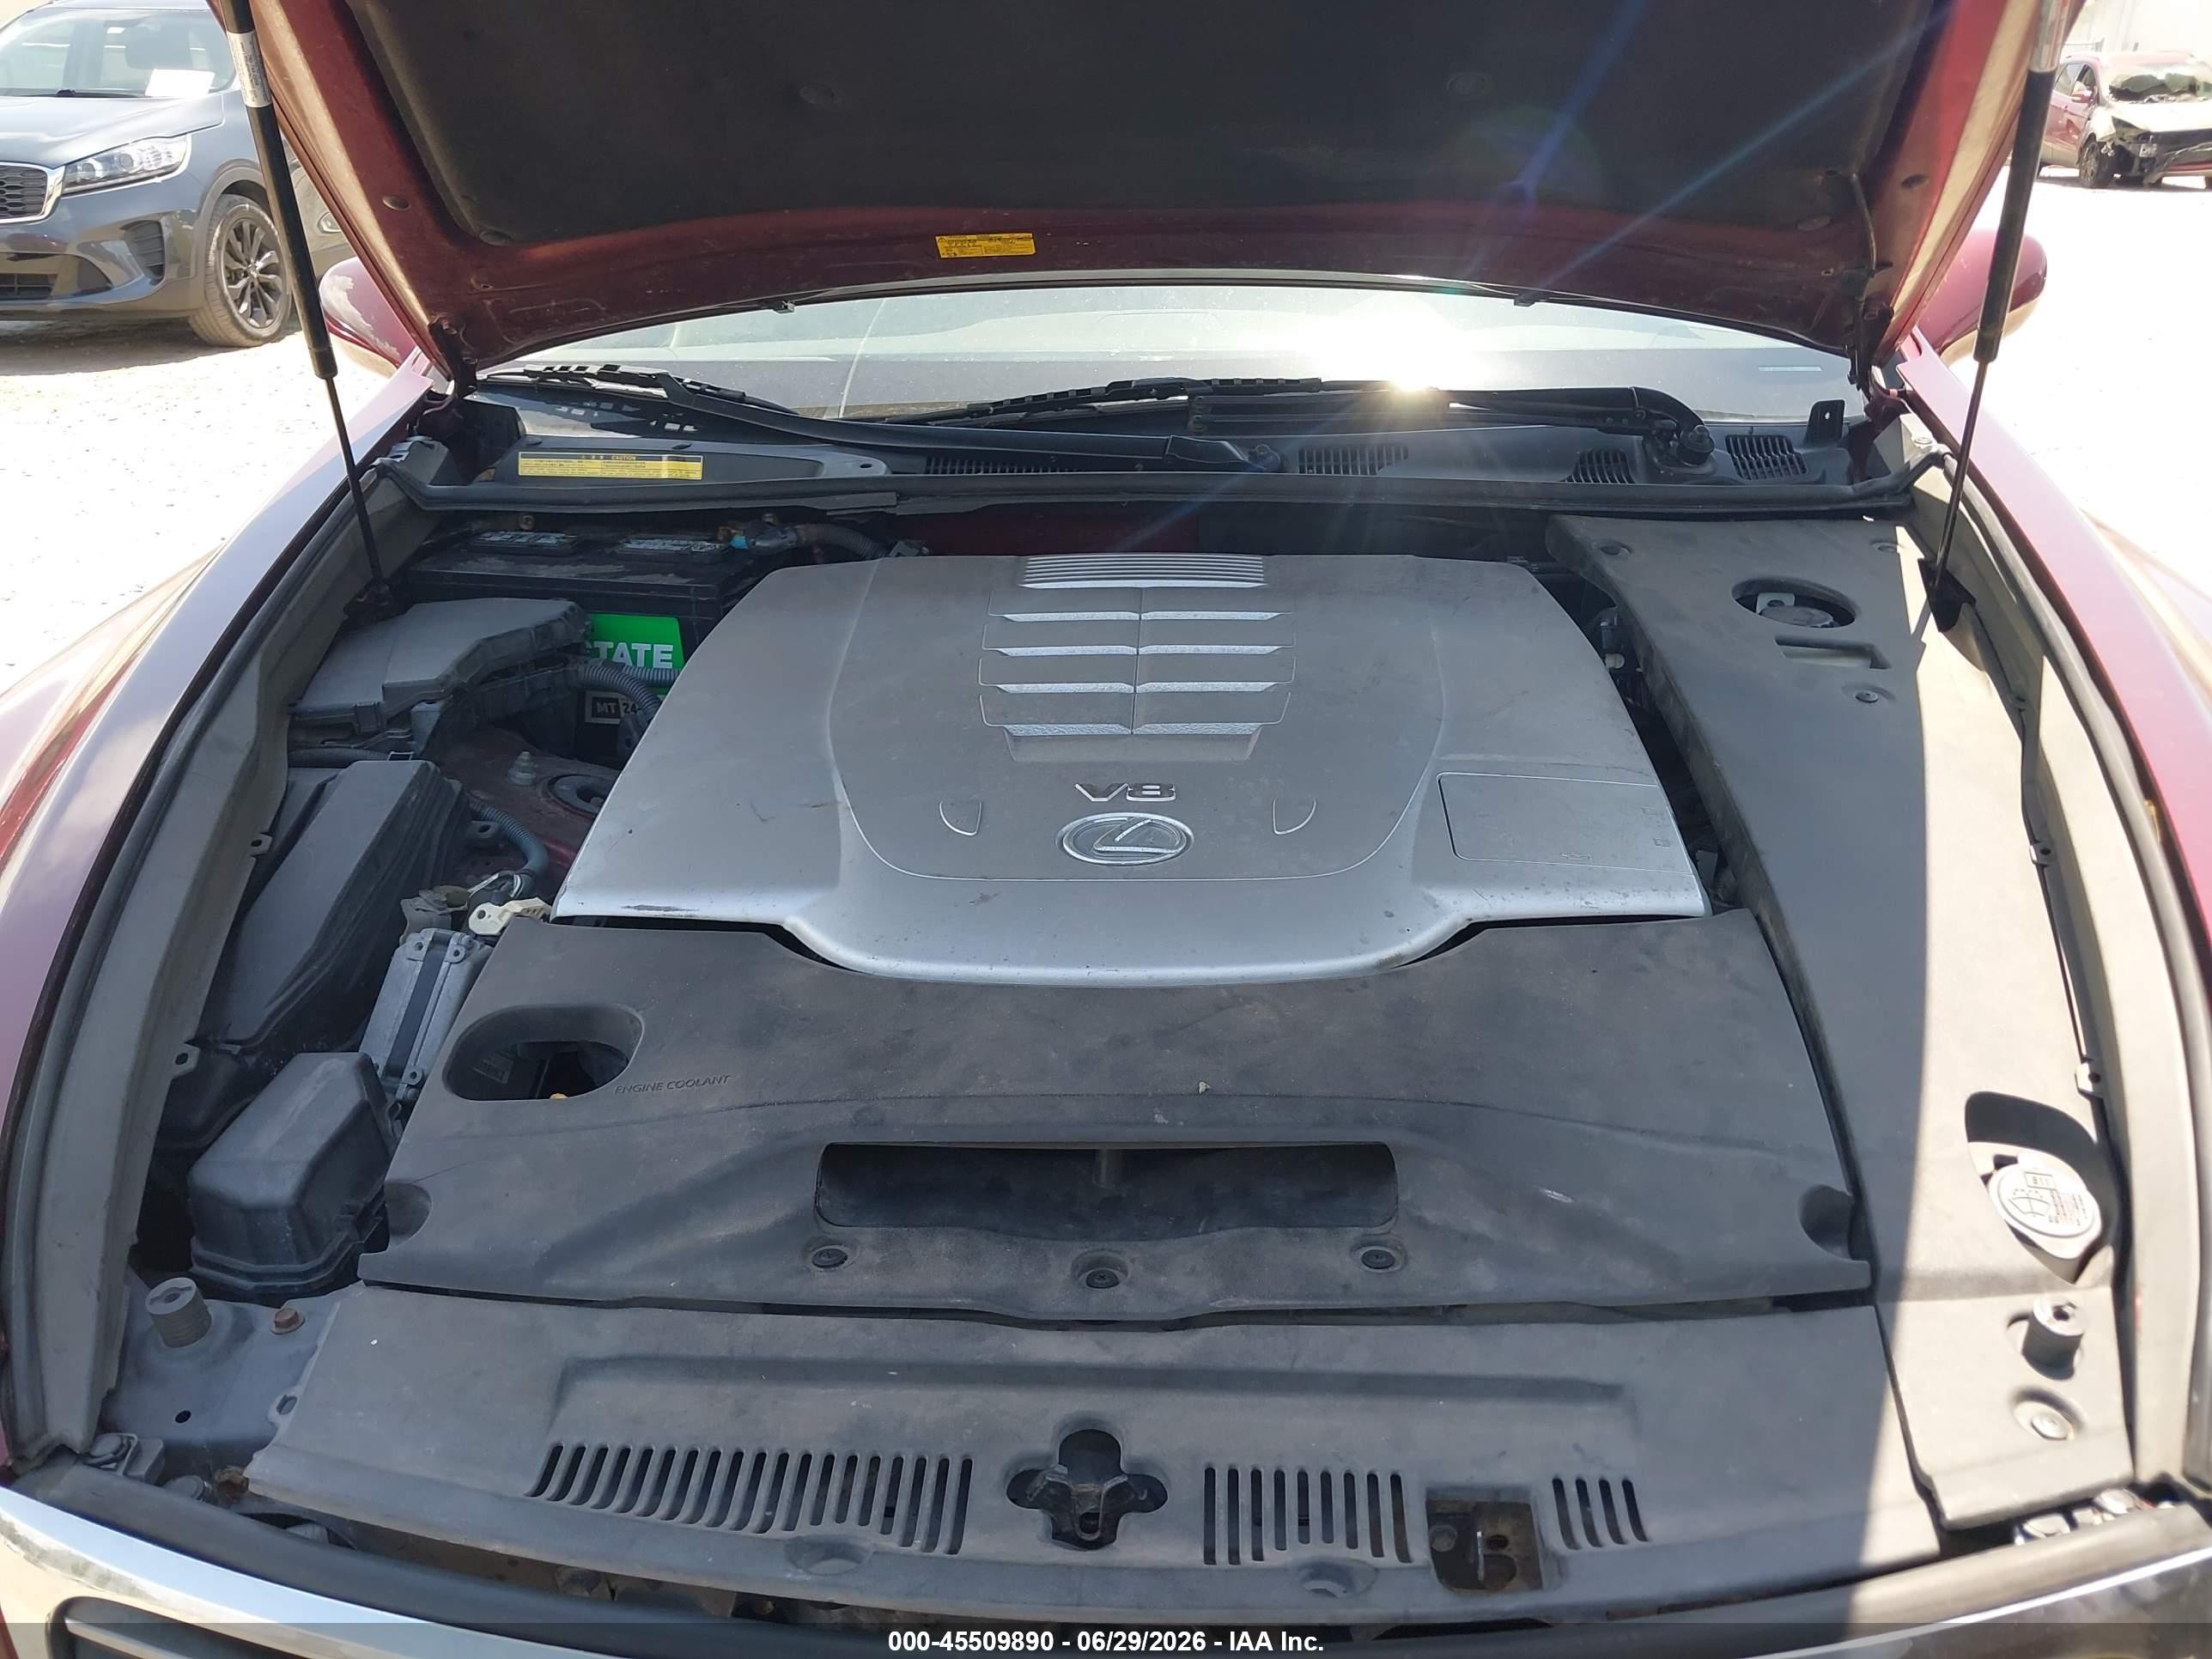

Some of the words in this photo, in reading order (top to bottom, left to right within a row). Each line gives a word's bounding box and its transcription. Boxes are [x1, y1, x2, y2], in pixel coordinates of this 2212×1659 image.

[596, 702, 617, 714] MT
[1075, 782, 1176, 802] V8
[614, 1082, 664, 1095] ENGINE
[666, 1074, 732, 1091] COOLANT
